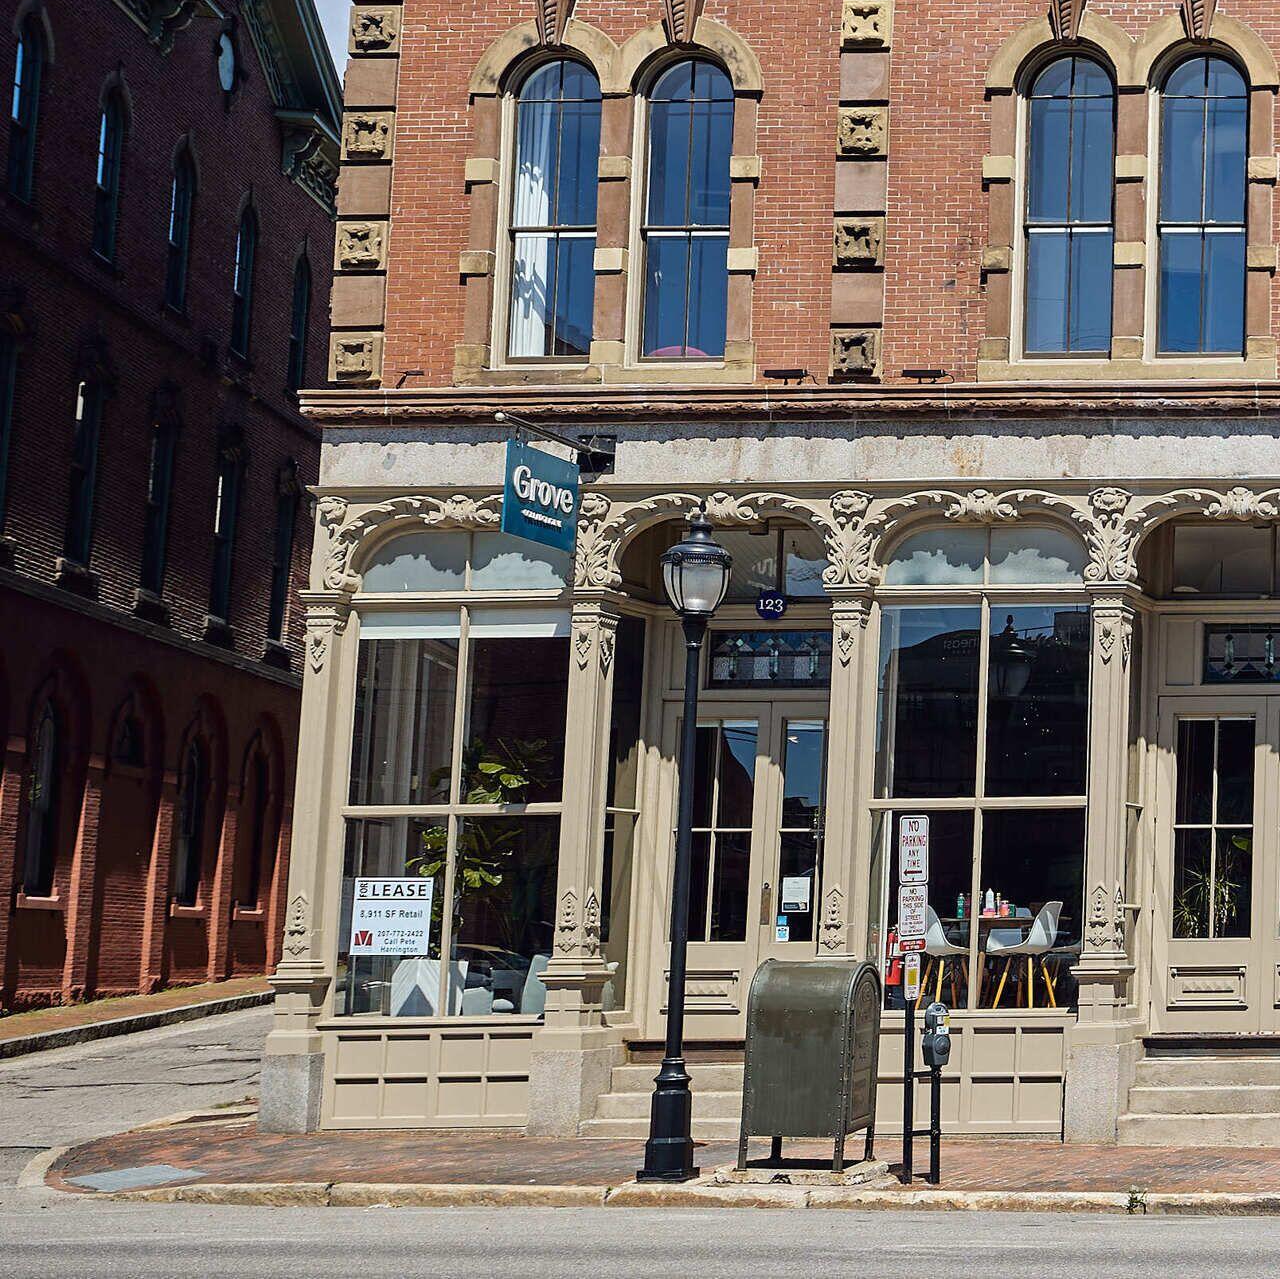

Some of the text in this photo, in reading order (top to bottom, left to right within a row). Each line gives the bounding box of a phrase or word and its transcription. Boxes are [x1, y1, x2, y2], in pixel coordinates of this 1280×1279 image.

[513, 465, 574, 513] Grove
[759, 599, 784, 613] 123
[909, 820, 920, 832] NO
[902, 835, 926, 846] PARKING
[908, 849, 919, 857] ANY
[907, 859, 921, 868] TIME
[359, 881, 369, 898] FOR
[372, 884, 427, 897] LEASE
[385, 910, 397, 918] SF
[399, 910, 423, 918] Retail
